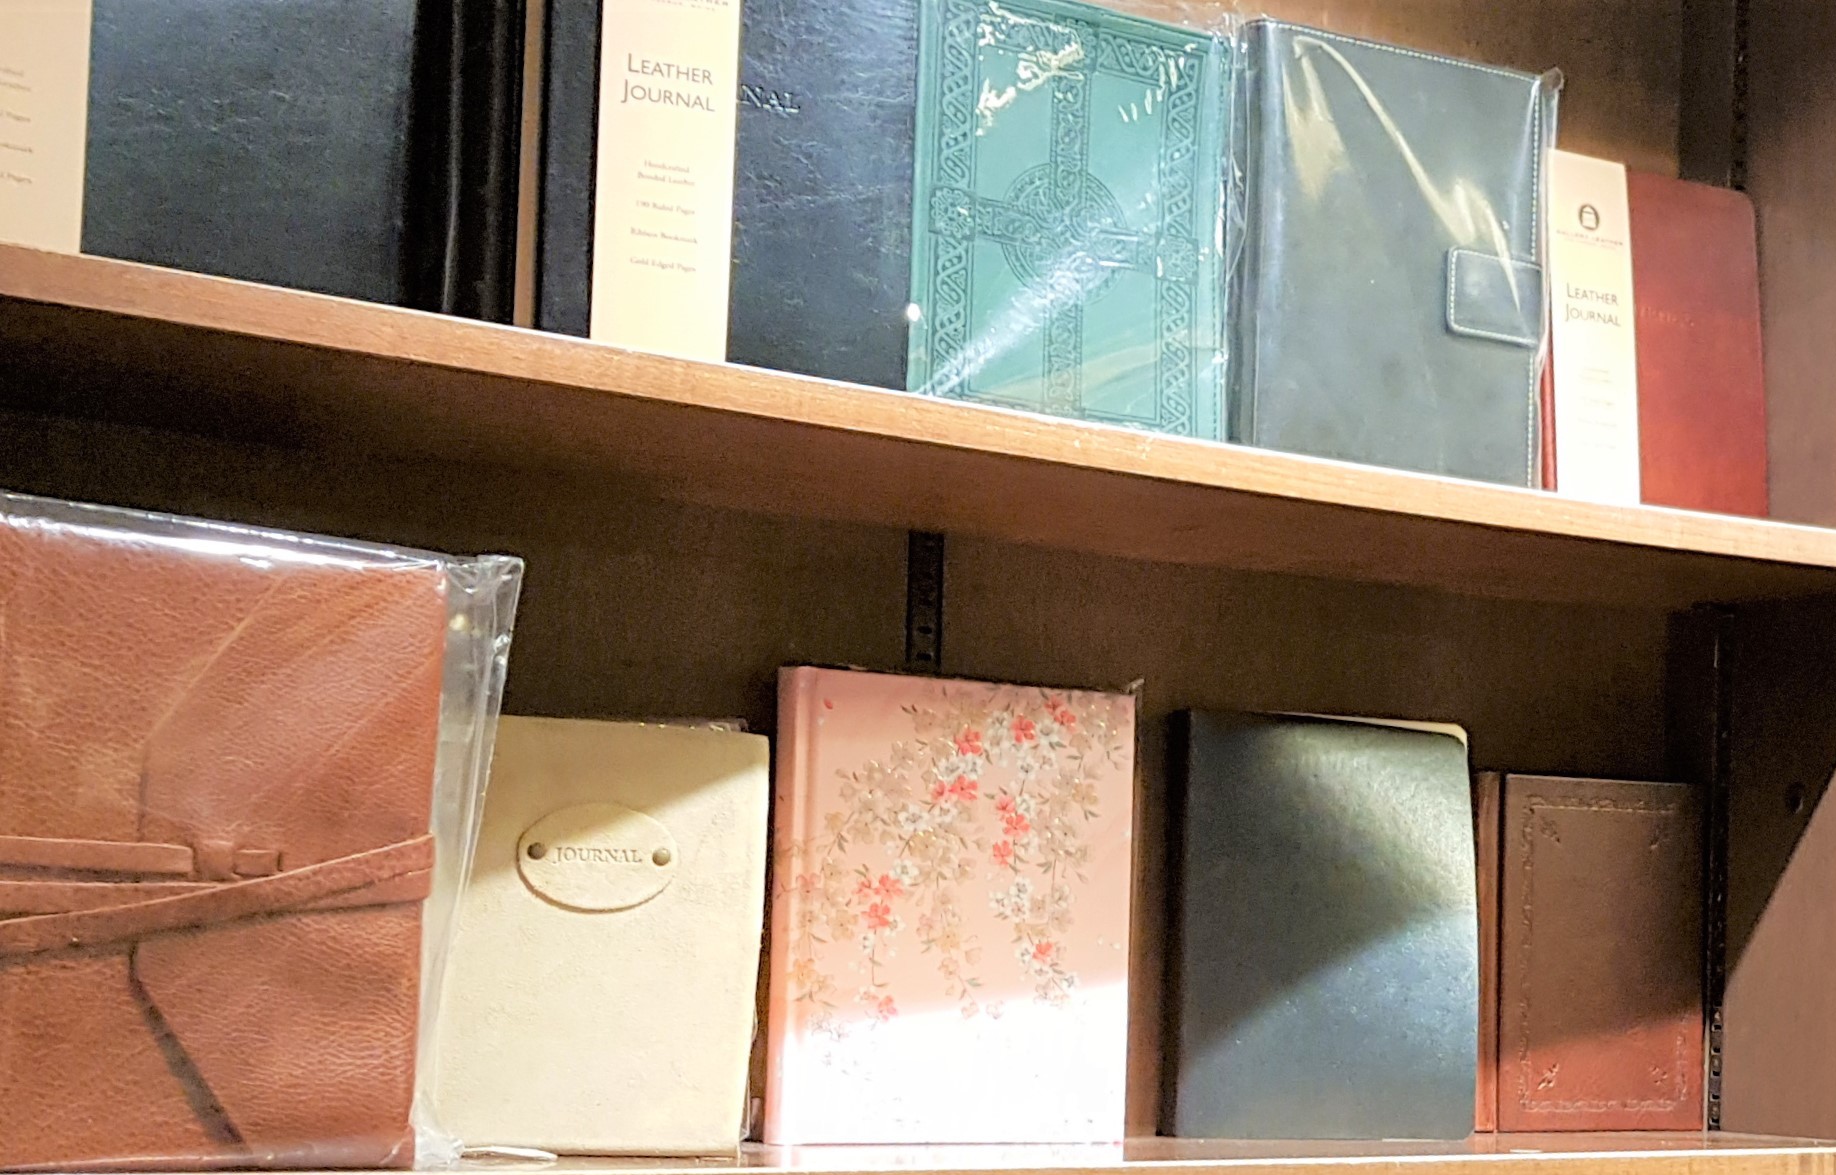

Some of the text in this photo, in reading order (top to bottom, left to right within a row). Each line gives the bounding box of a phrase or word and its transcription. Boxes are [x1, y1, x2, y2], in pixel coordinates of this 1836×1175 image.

[628, 53, 713, 85] LEATHER
[621, 79, 715, 112] JOURNAL
[1566, 282, 1619, 306] LEATHER
[1565, 303, 1621, 327] JOURNAL
[552, 846, 643, 864] JOURNAL
